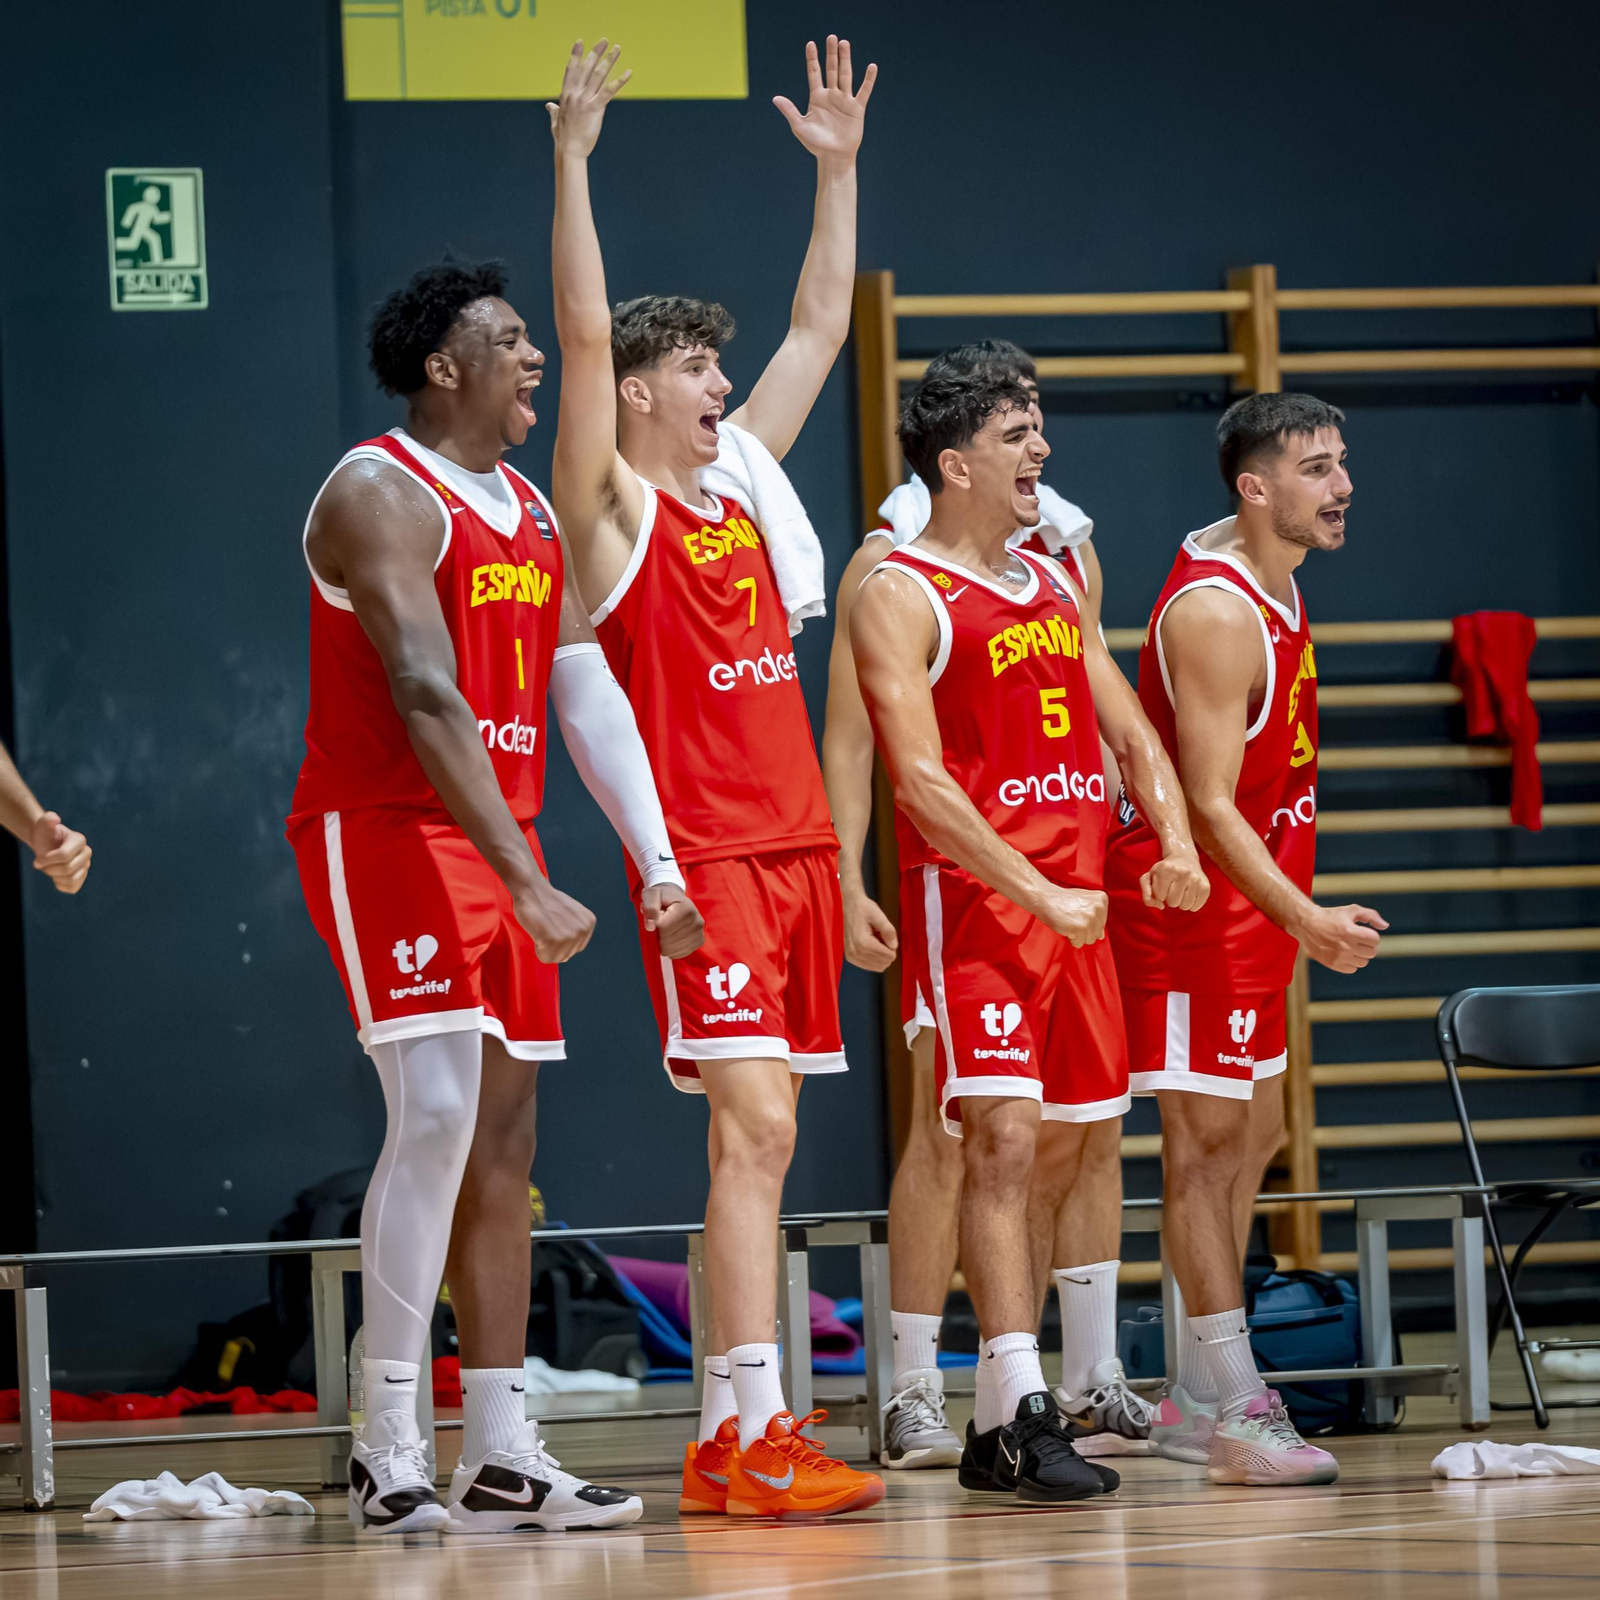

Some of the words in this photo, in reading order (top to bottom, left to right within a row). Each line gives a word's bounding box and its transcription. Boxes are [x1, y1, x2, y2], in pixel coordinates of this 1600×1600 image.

[123, 274, 197, 293] SALIDA
[733, 576, 757, 627] 7
[1039, 687, 1071, 738] 5
[389, 978, 452, 1000] tenerife!
[702, 1008, 763, 1025] tenerife!
[973, 1047, 1031, 1065] tenerife!
